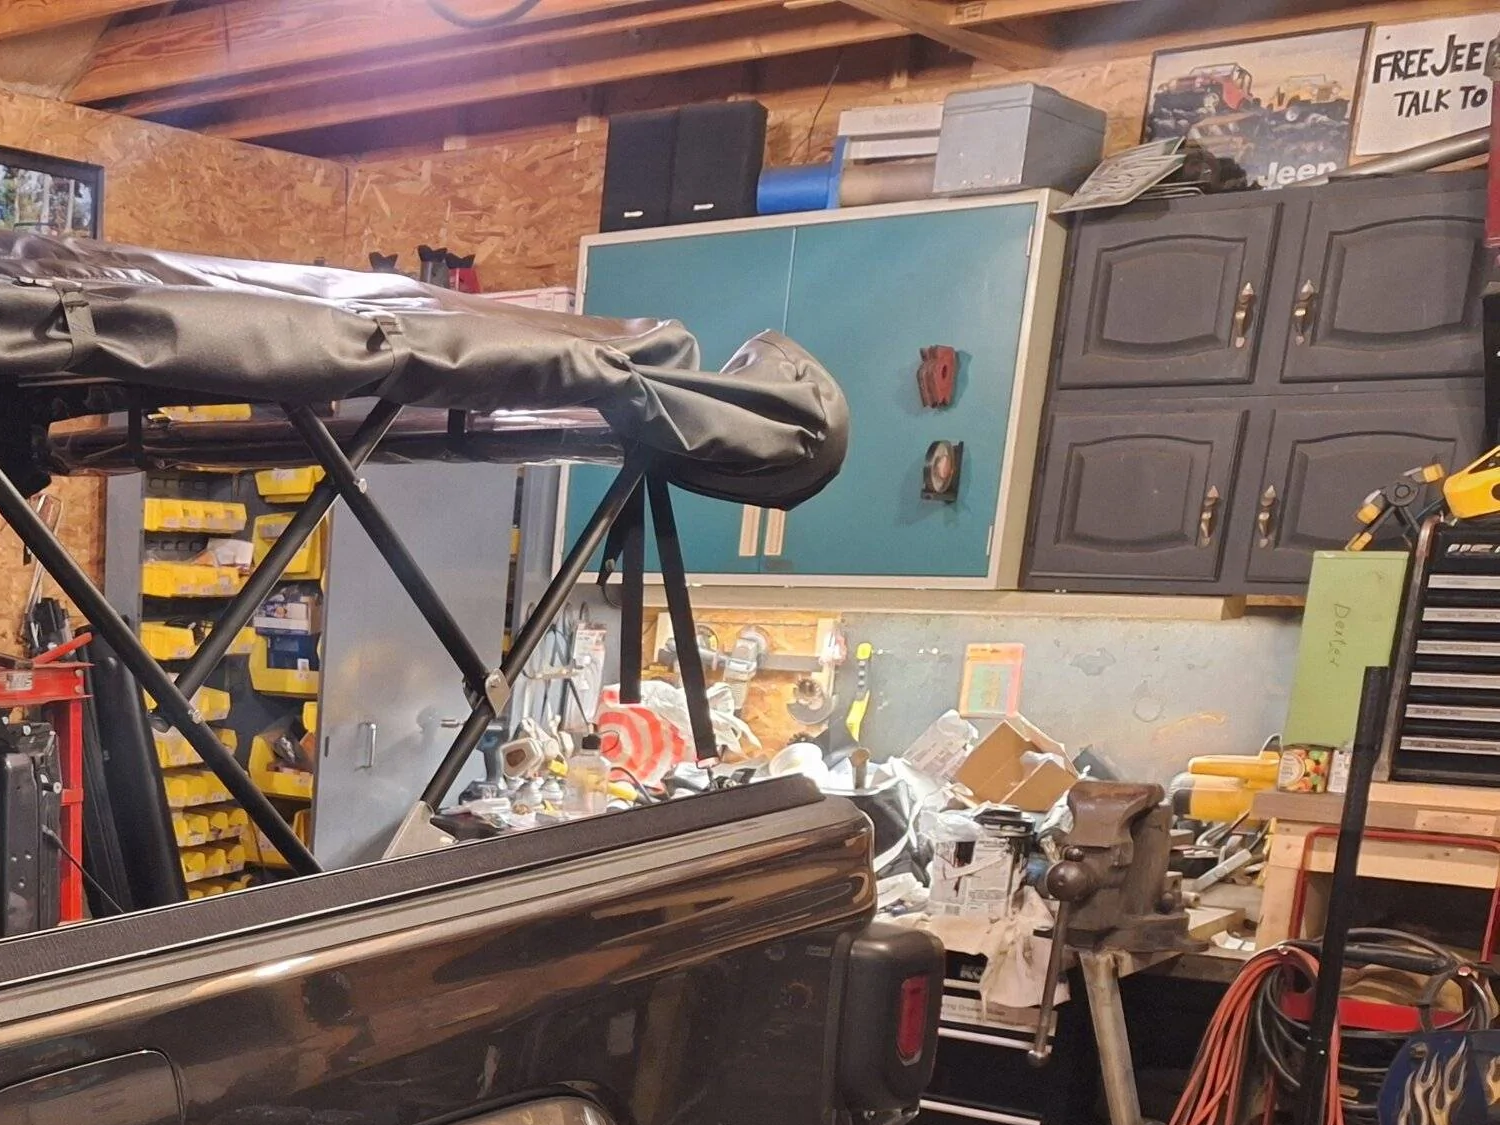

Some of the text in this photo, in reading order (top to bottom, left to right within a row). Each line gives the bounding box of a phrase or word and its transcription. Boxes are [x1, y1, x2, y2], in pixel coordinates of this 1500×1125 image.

[1372, 33, 1484, 84] FREE JEE
[1394, 85, 1488, 118] TALK TO
